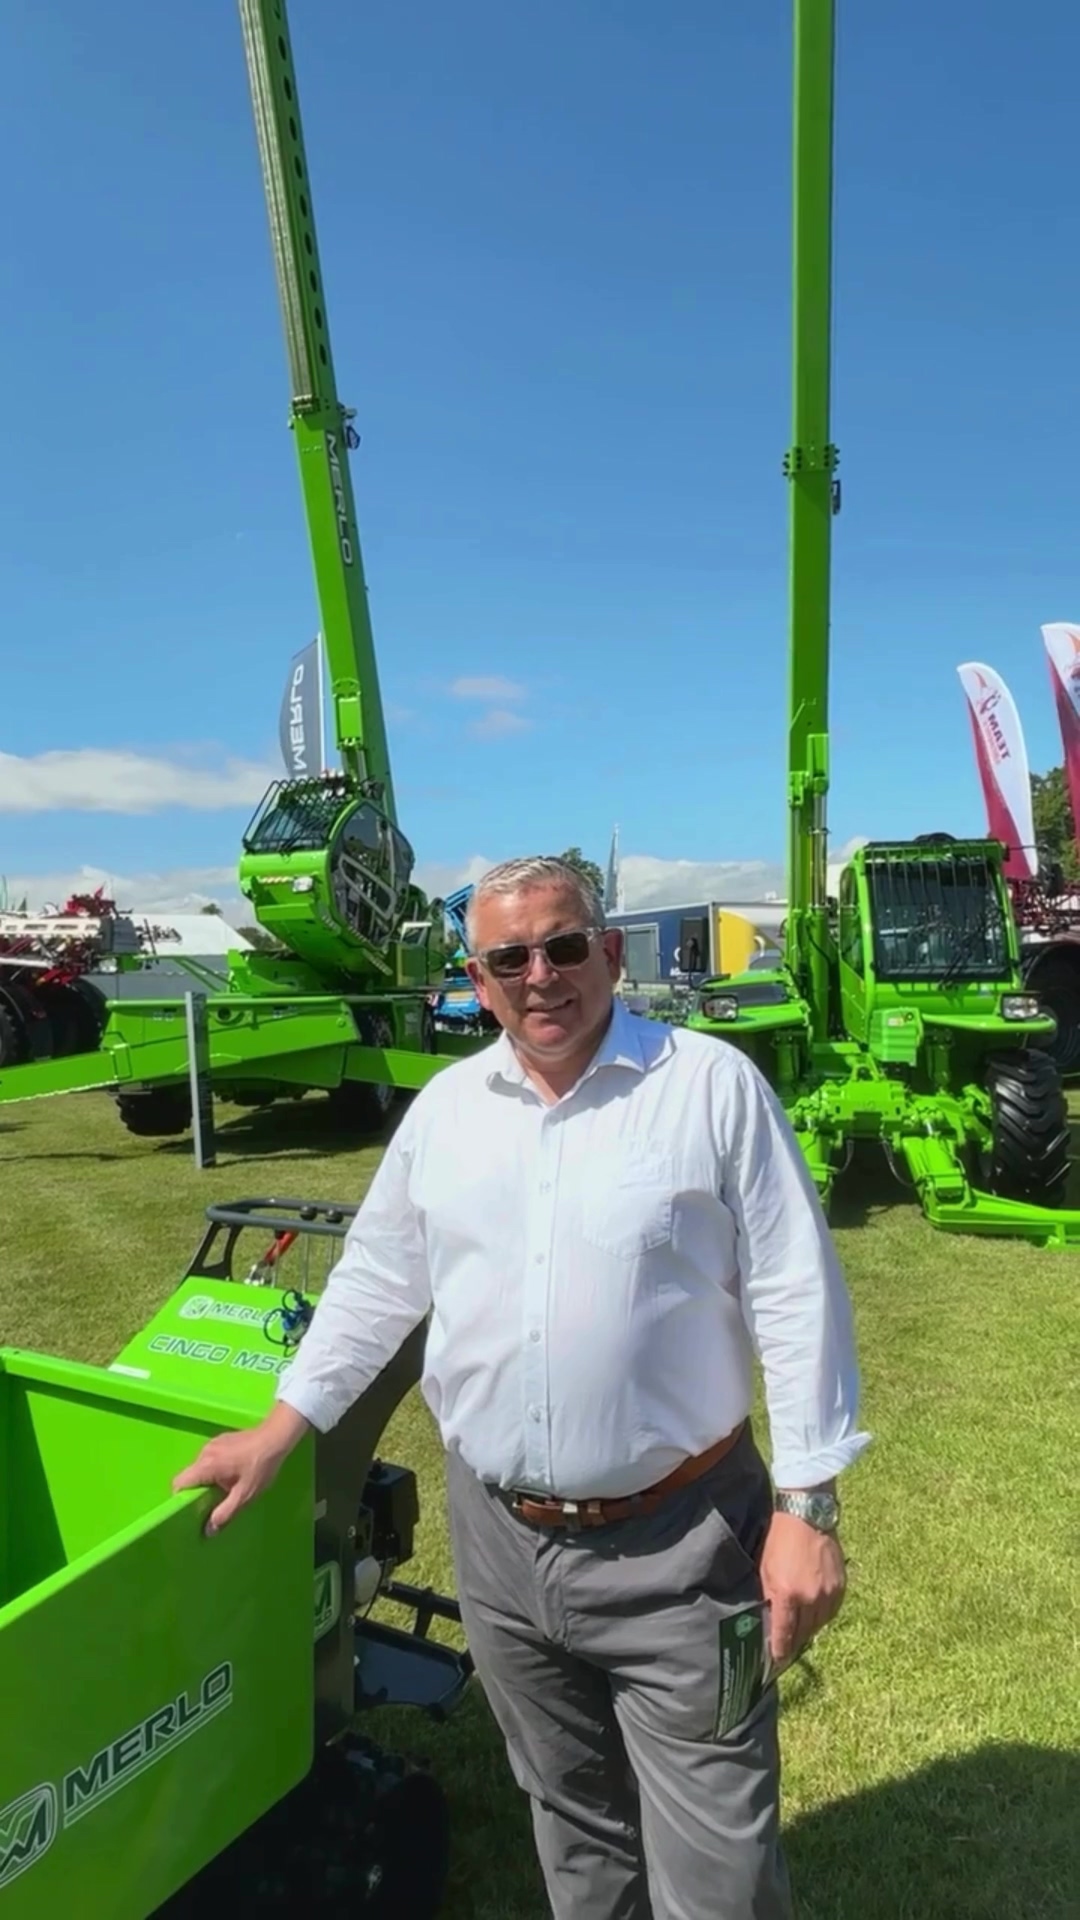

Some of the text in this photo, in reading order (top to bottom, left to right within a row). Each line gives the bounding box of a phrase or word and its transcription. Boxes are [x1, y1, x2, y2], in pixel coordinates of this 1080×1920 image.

[326, 433, 353, 564] MERLO
[149, 1334, 230, 1363] CINGO
[210, 1301, 278, 1325] MERLO
[64, 1661, 232, 1814] MERLO
